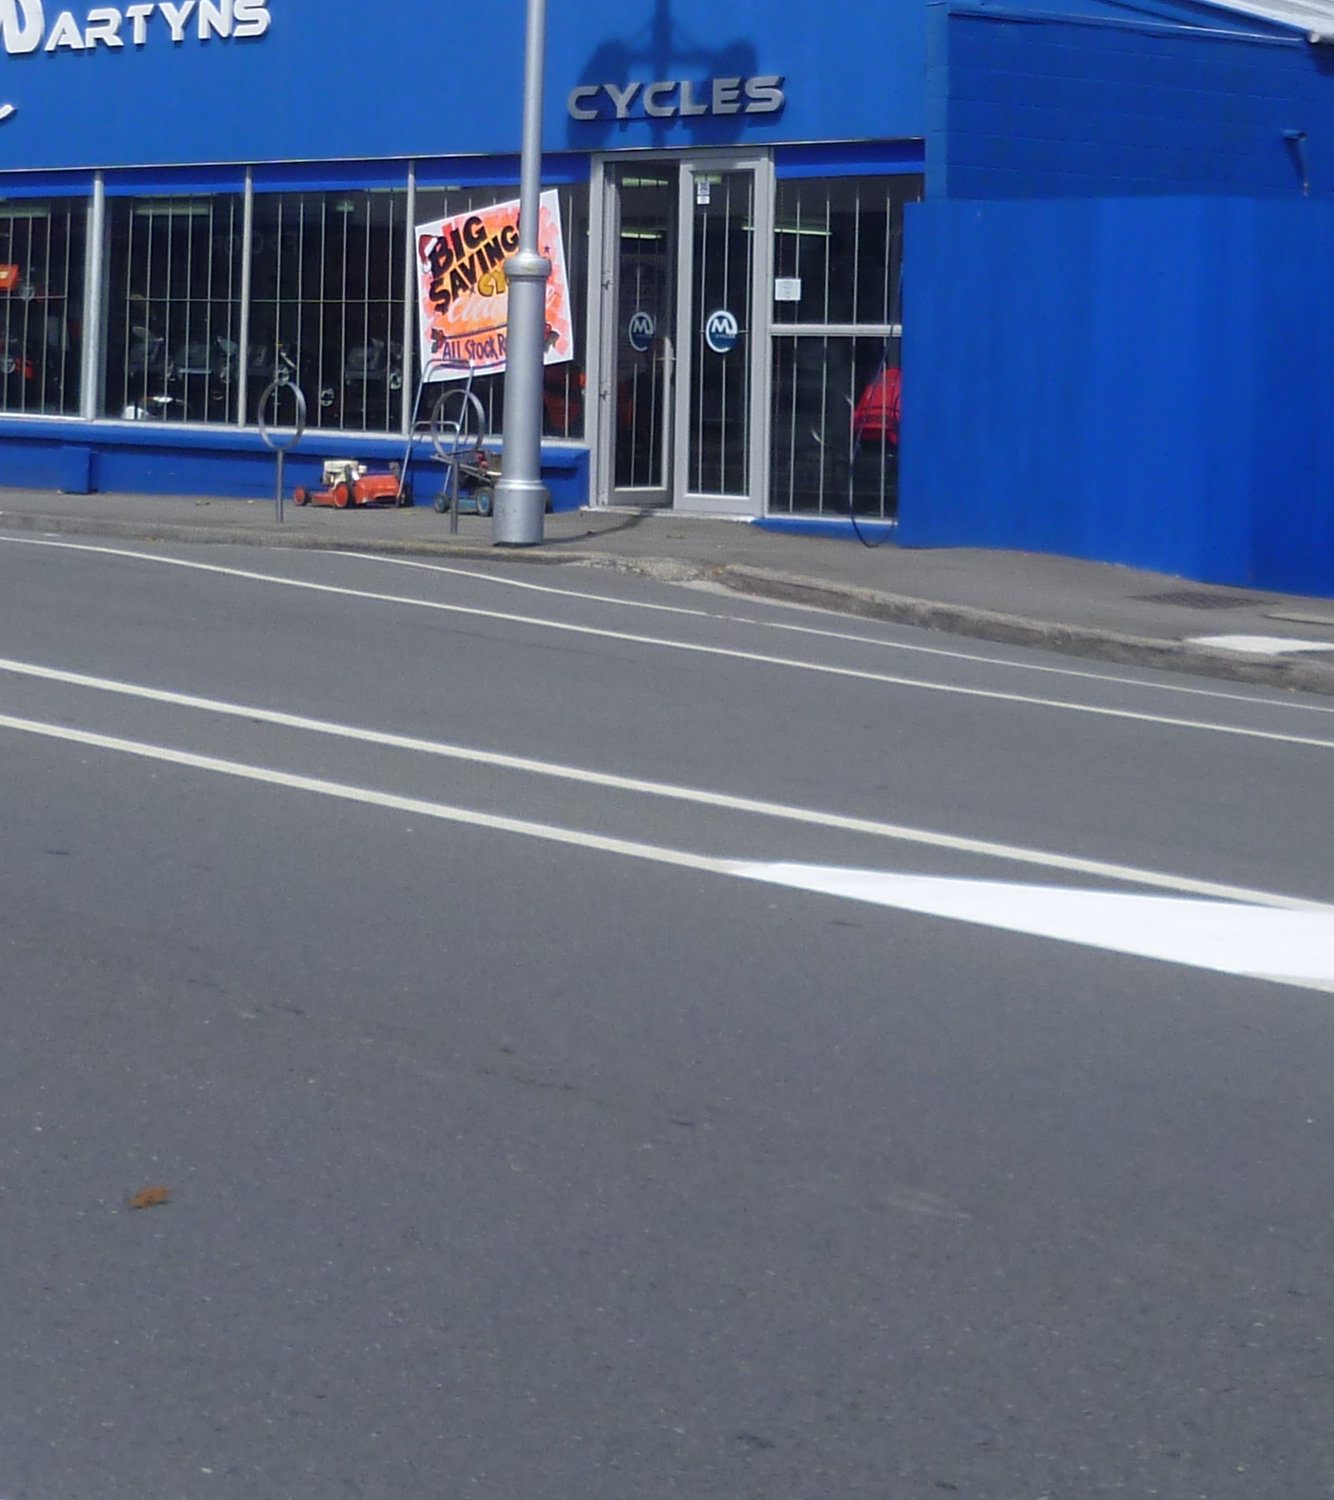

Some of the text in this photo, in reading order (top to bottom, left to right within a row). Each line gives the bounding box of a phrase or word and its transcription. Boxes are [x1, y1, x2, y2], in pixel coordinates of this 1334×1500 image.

[567, 75, 785, 121] CYCLES
[429, 216, 488, 279] BIG
[429, 213, 521, 315] SAVING
